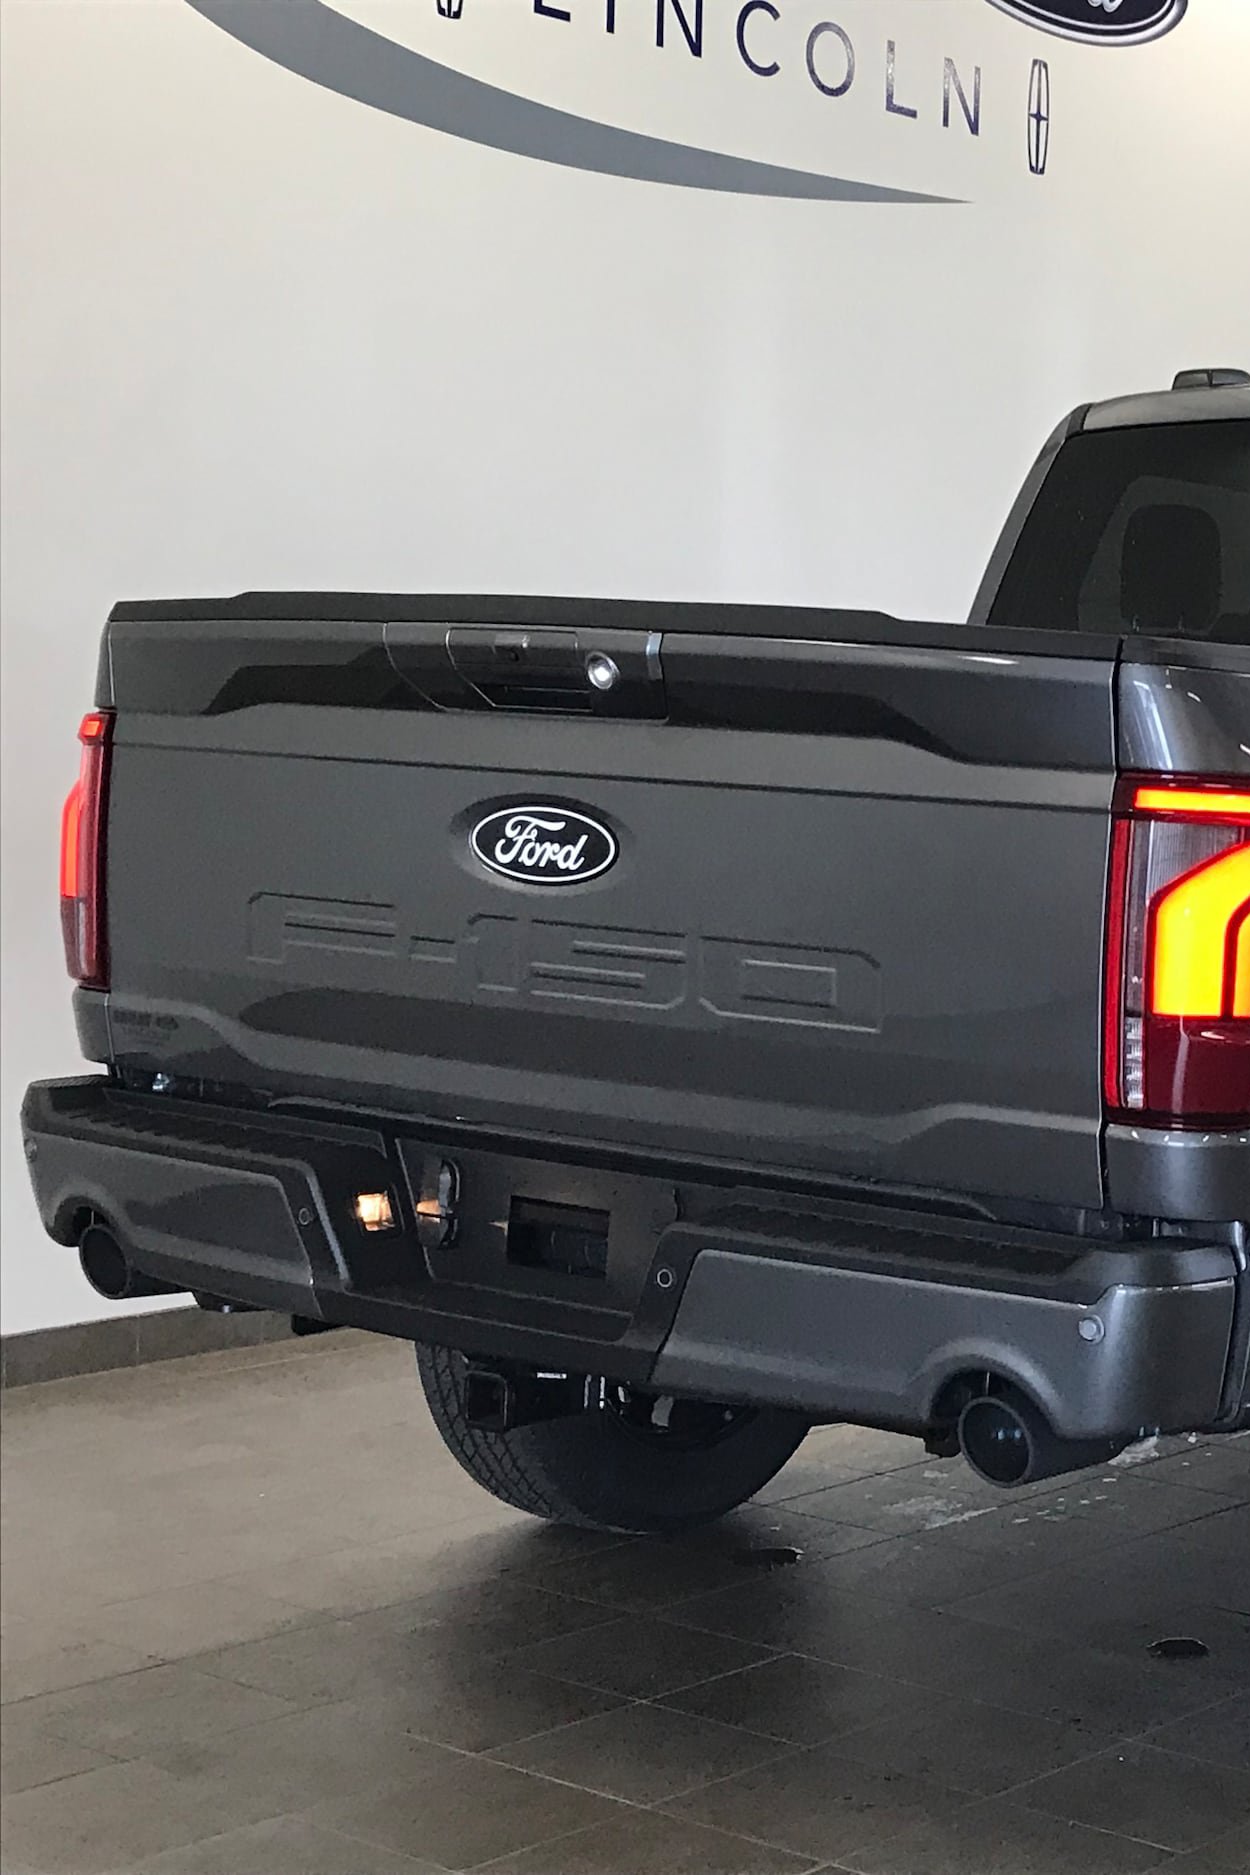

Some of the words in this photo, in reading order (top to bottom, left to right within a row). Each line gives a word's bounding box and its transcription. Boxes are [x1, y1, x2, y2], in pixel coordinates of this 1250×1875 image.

[534, 0, 981, 136] NCOLN
[494, 815, 589, 871] Ford
[247, 892, 882, 1034] F-150
